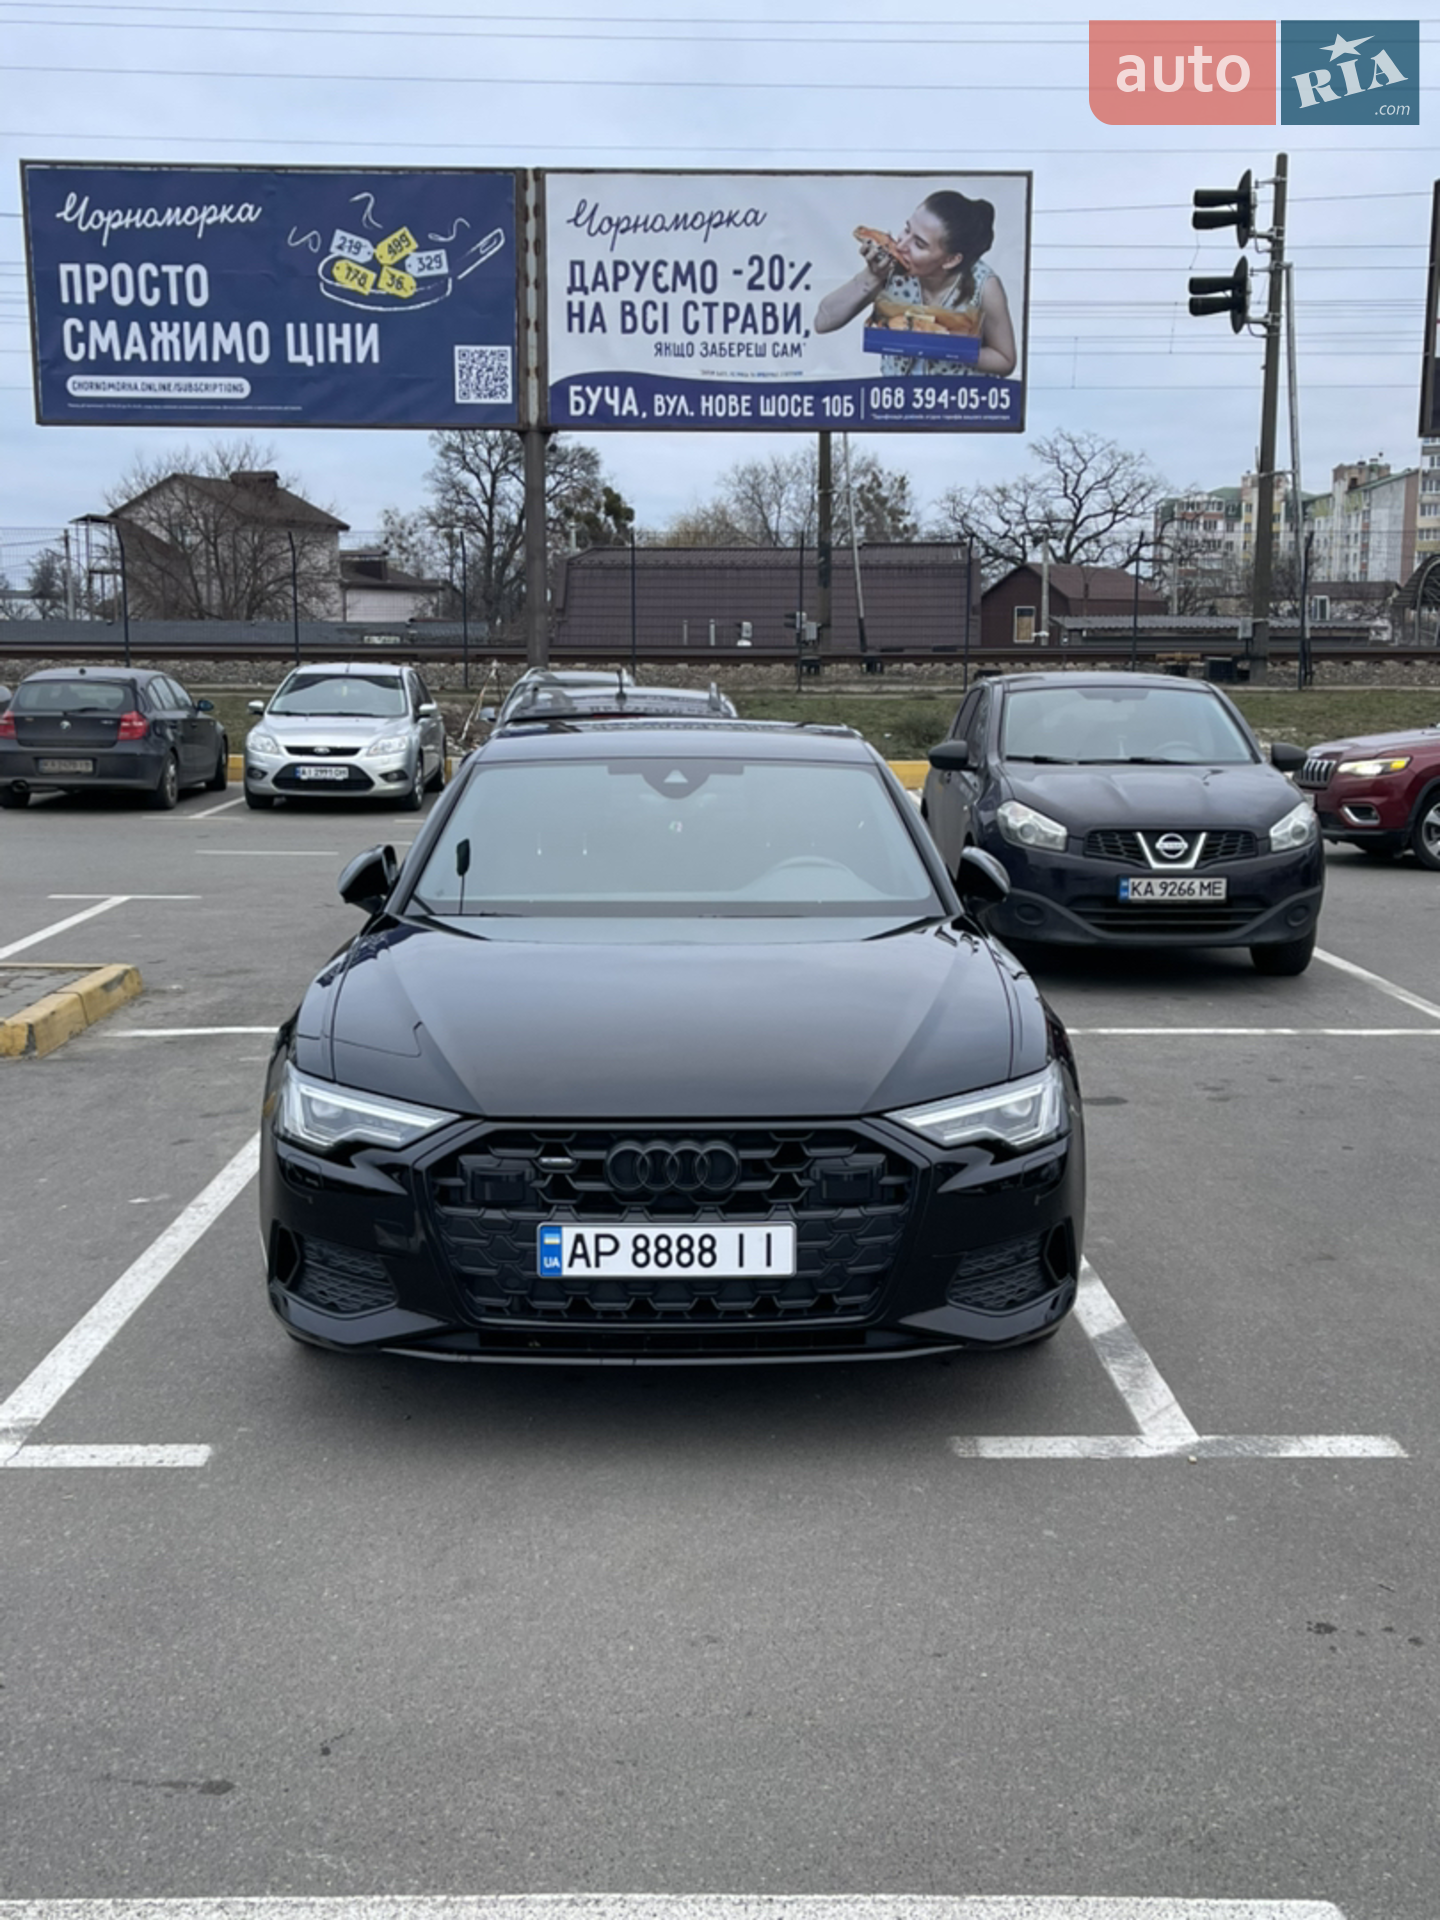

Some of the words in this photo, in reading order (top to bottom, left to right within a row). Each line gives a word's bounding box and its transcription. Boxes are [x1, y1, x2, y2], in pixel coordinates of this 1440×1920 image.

[55, 192, 262, 247] Чорноморка
[566, 199, 767, 252] Чорноморка
[335, 236, 364, 256] 219
[416, 253, 443, 273] 329
[59, 262, 210, 307] ПРОСТО
[566, 259, 718, 295] ДАРУЄМО
[732, 254, 813, 291] -20%
[567, 300, 607, 334] НА
[620, 300, 669, 335] ВСІ
[682, 300, 811, 338] СТРАВИ,
[63, 317, 271, 364] СМАЖИМО
[286, 322, 380, 366] ЦІНИ
[700, 341, 767, 358] ЗАБЕРЕШ
[569, 385, 647, 418] БУЧА,
[654, 395, 695, 417] ВУЛ.
[701, 395, 752, 417] НОВЕ
[760, 395, 815, 417] ШОСЕ
[821, 395, 855, 417] 10Б
[870, 387, 905, 409] 068
[912, 387, 1010, 409] 394-05-05
[1131, 881, 1155, 897] KA
[1159, 881, 1195, 897] 9266
[1199, 881, 1223, 897] ME
[543, 1256, 561, 1268] UA
[568, 1233, 621, 1268] AP
[631, 1233, 717, 1269] 8888
